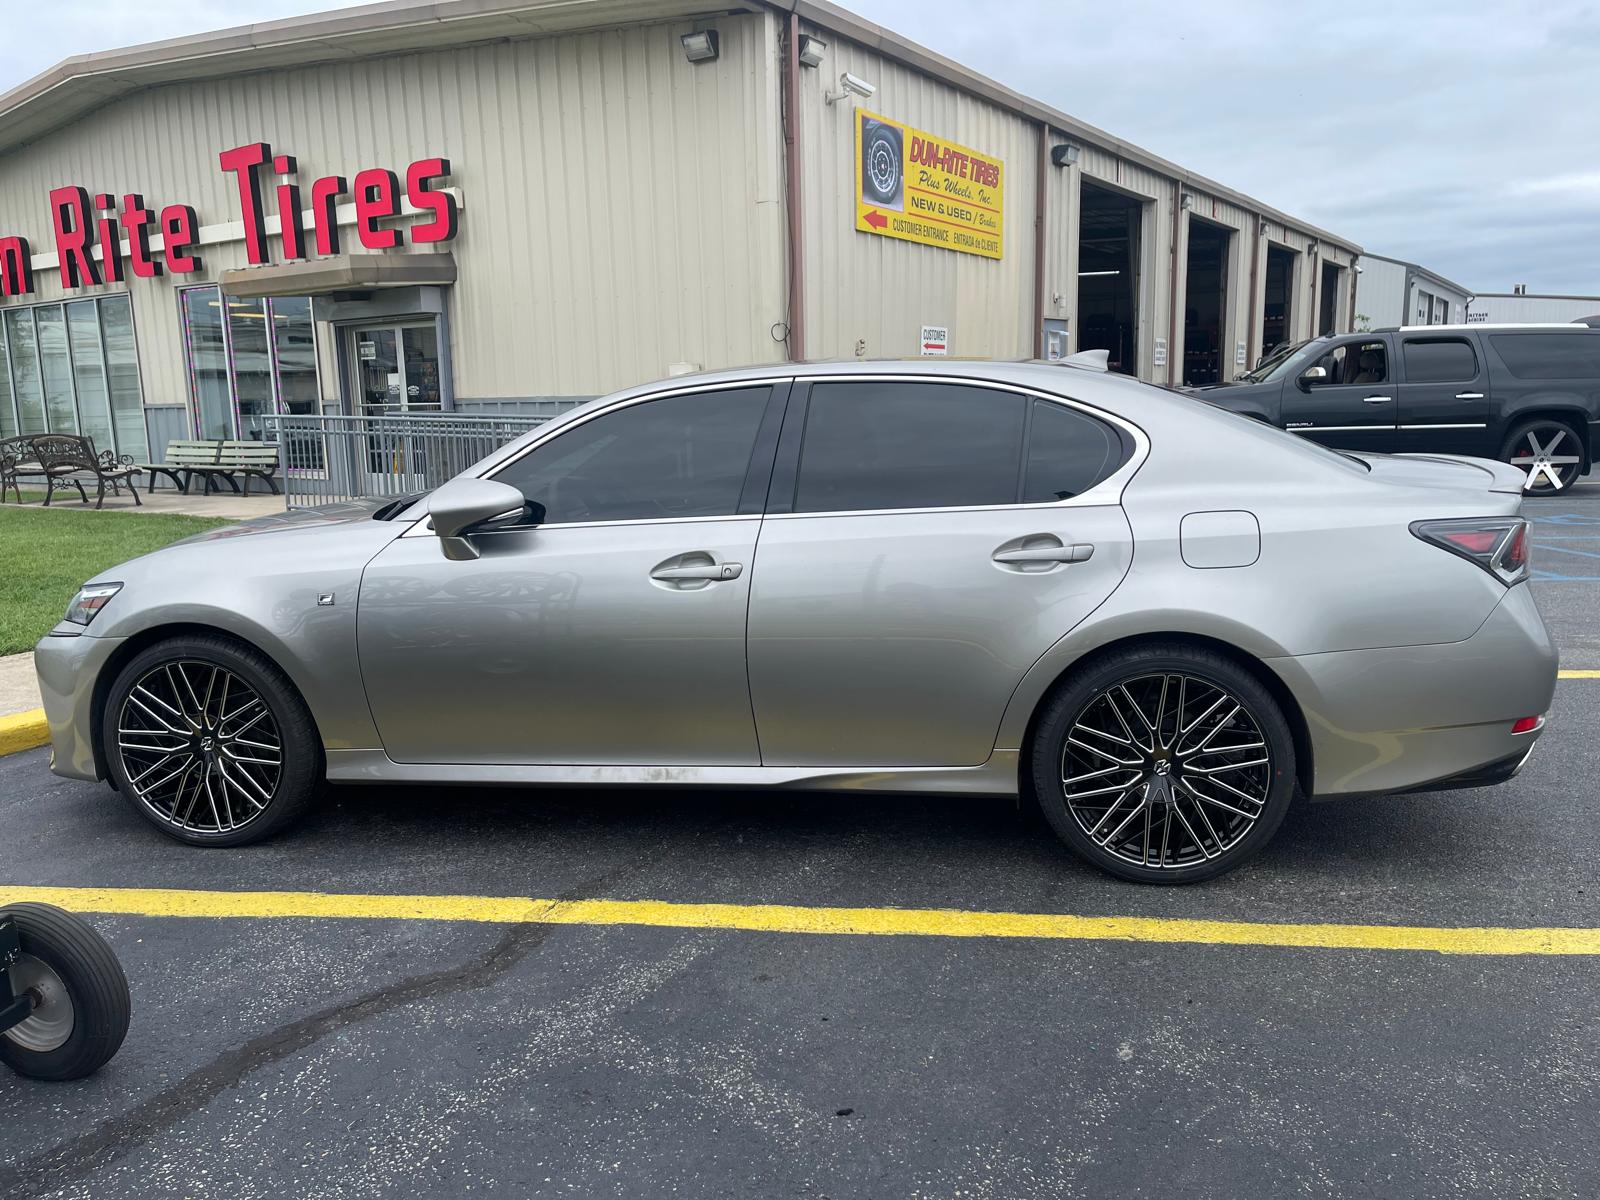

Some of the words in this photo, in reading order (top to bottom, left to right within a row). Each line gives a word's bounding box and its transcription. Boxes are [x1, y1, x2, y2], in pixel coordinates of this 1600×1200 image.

[909, 136, 969, 179] DUN-RITE
[969, 156, 1000, 189] TIRES
[918, 170, 940, 190] Plus
[50, 185, 202, 288] Rite
[219, 142, 458, 264] Tires
[911, 196, 936, 212] NEW
[937, 203, 945, 214] &
[946, 205, 972, 221] USED
[892, 218, 922, 234] CUSTOMER
[923, 225, 949, 242] ENTRANCE
[953, 232, 974, 249] ENTRADA
[923, 329, 946, 341] CUSTOMER
